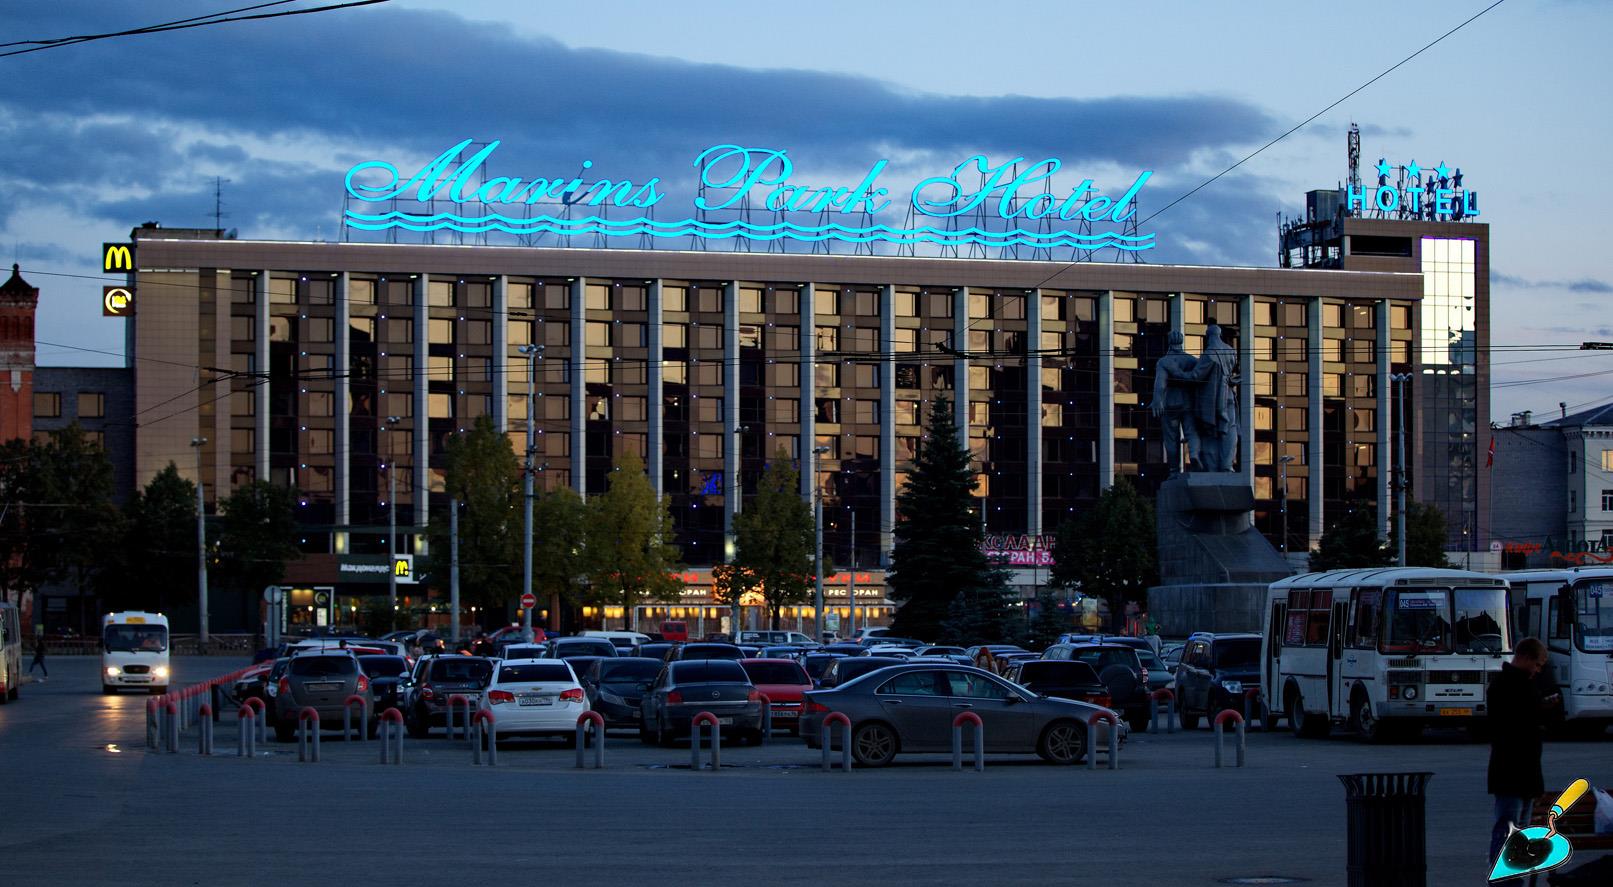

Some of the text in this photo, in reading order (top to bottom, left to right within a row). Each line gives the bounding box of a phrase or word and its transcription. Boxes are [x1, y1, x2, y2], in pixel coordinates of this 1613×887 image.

[345, 138, 1154, 223] Marins Park Hotel
[1347, 184, 1480, 216] HOTEL
